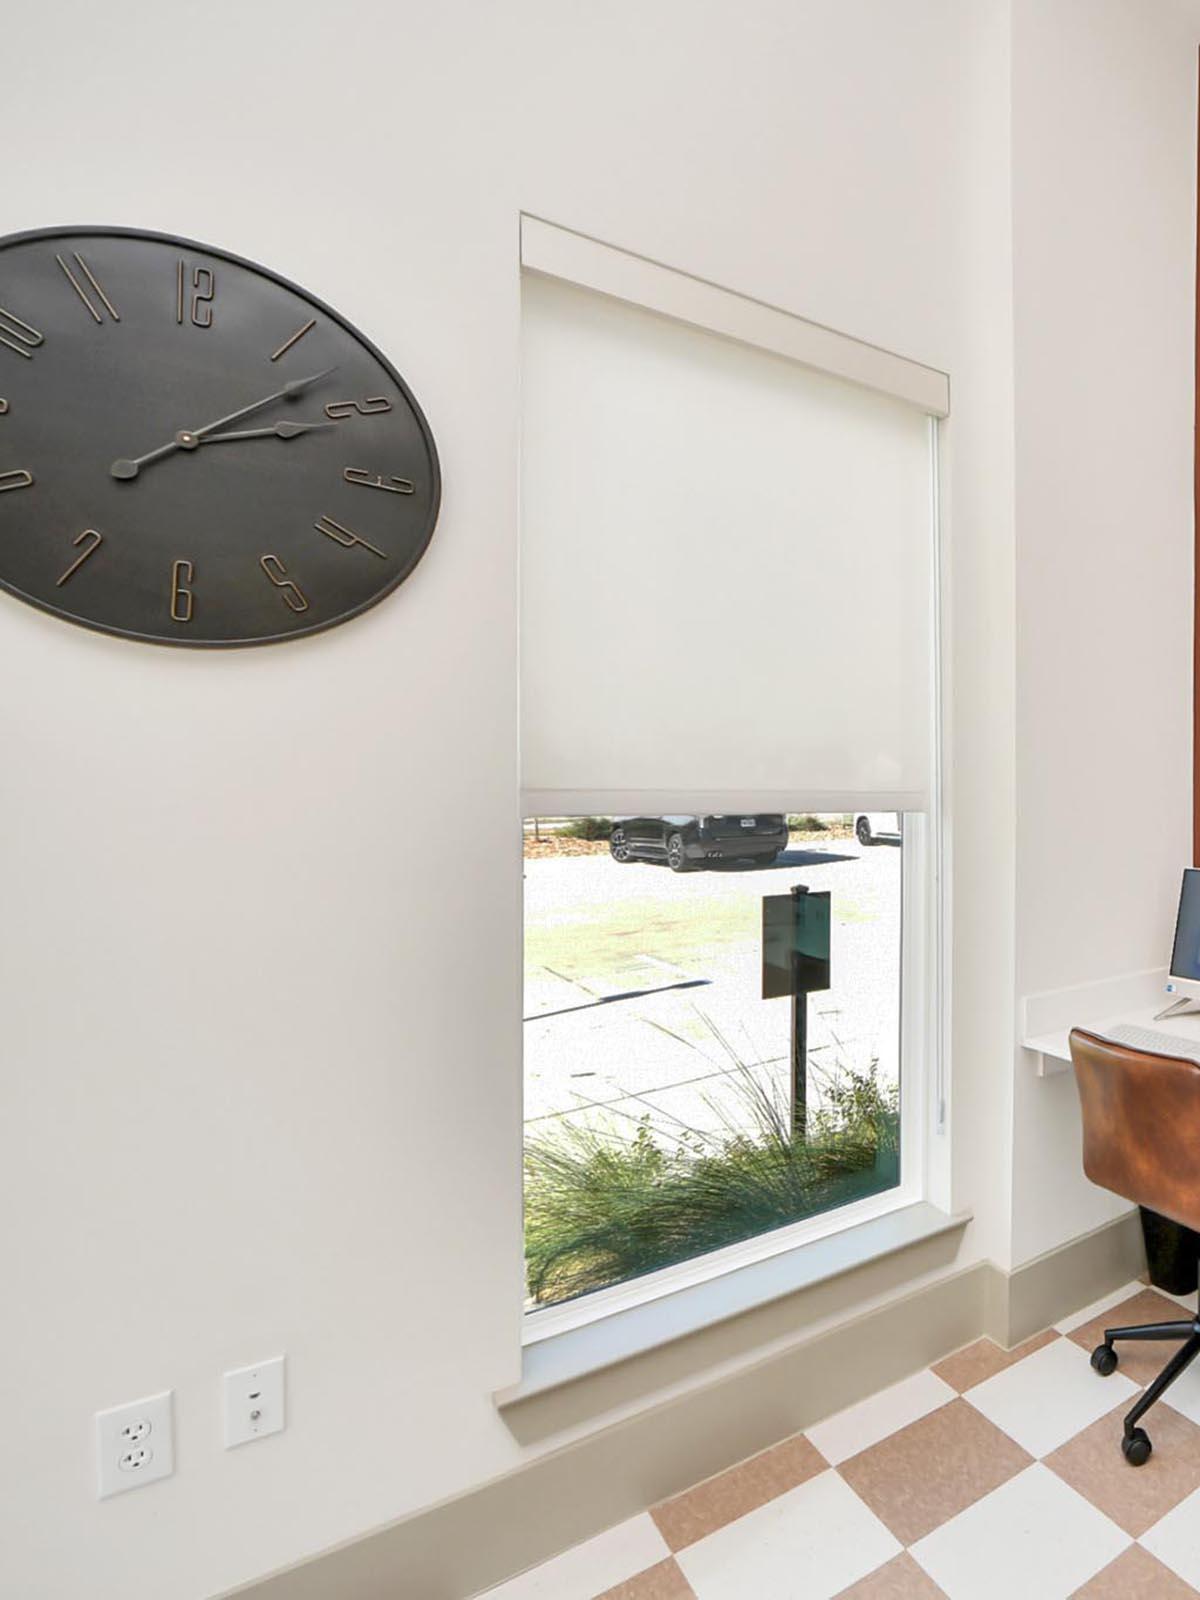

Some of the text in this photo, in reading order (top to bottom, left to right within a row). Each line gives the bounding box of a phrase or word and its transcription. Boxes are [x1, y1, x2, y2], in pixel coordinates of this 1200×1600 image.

[56, 251, 120, 324] 11
[176, 259, 214, 328] 12
[324, 396, 392, 419] 2
[344, 467, 416, 495] 3
[56, 529, 103, 587] 7
[259, 554, 309, 612] 5
[170, 559, 193, 622] 6
